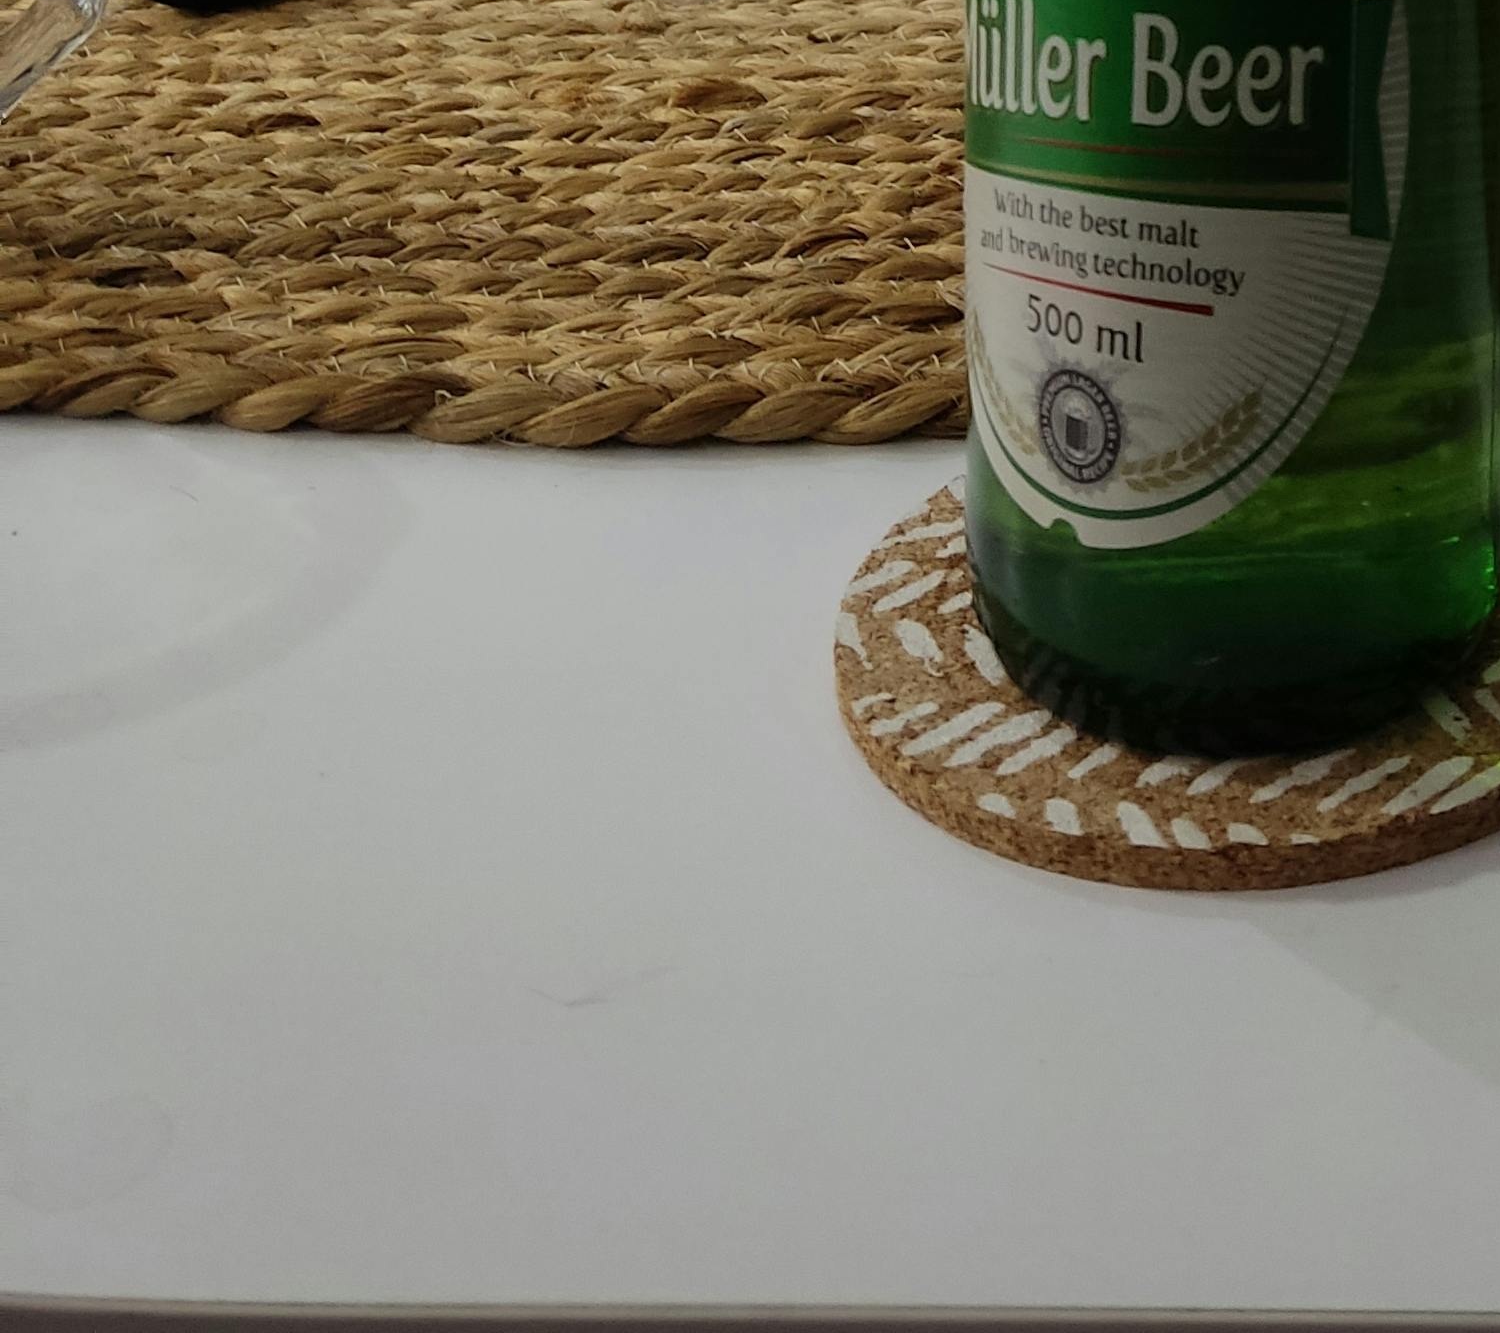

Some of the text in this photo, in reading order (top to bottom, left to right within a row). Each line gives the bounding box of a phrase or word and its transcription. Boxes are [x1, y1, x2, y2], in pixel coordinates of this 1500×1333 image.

[1131, 12, 1324, 127] Beer
[995, 188, 1200, 249] With the best malt
[981, 226, 1246, 297] and brewing technology
[1027, 293, 1144, 364] 500 ml
